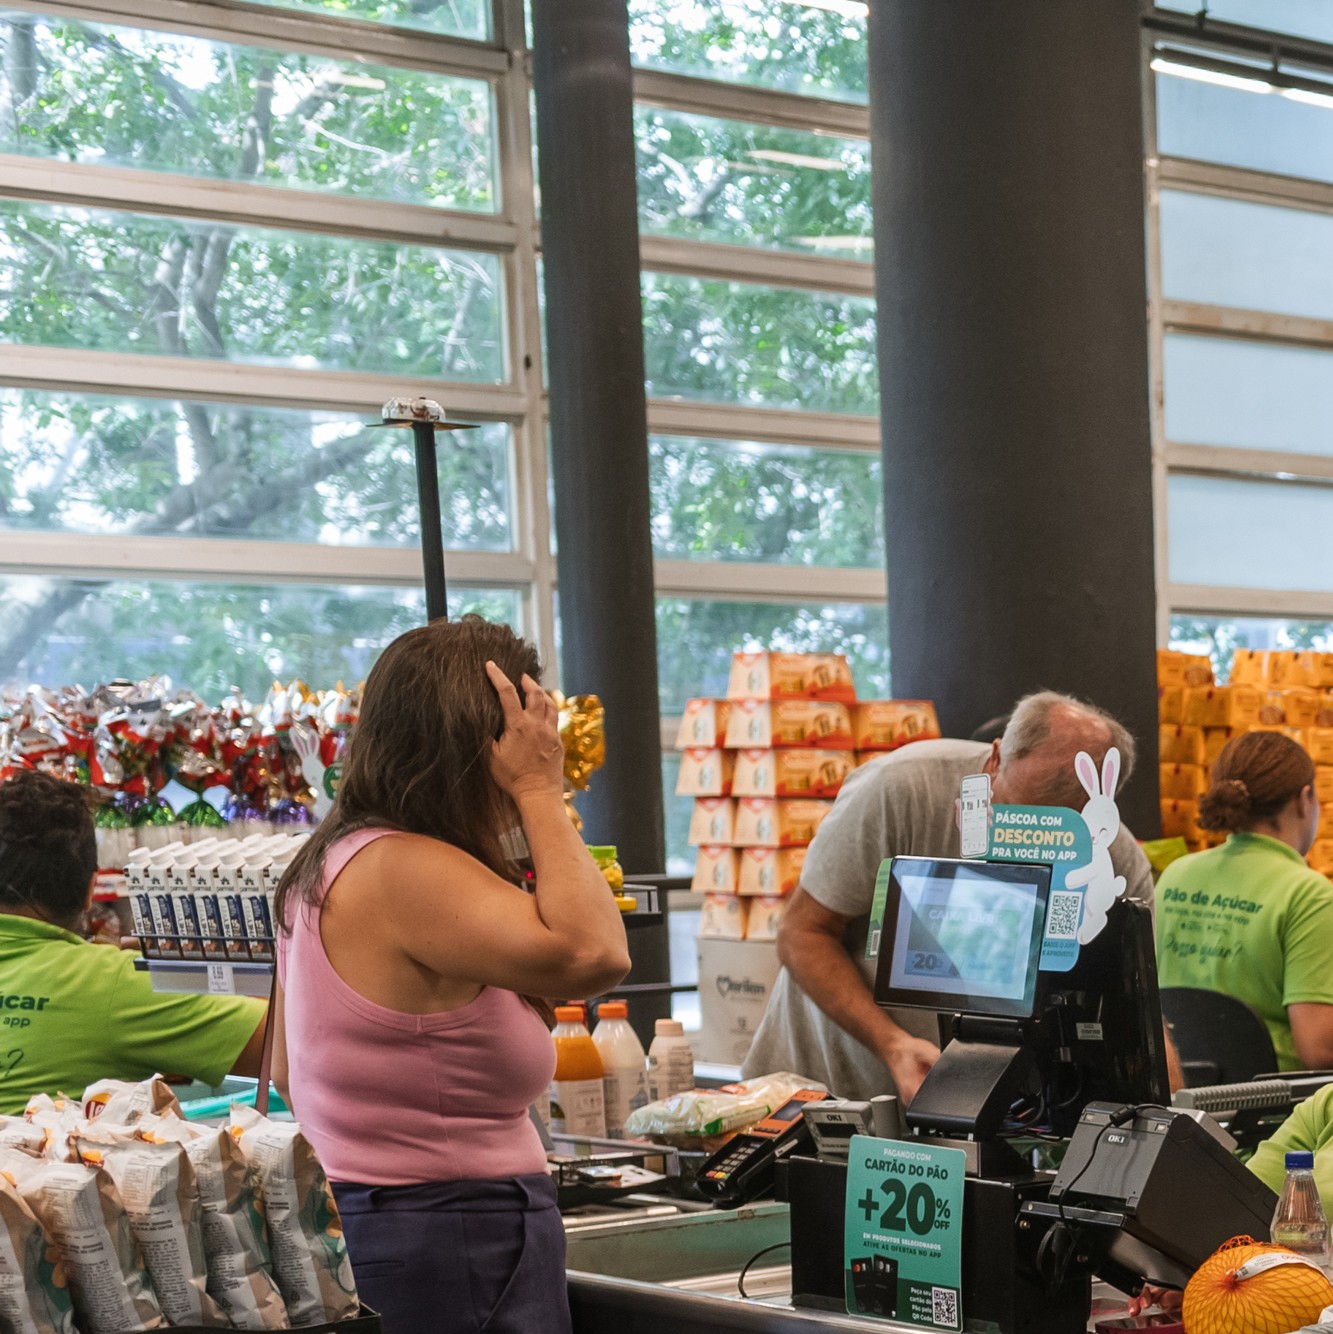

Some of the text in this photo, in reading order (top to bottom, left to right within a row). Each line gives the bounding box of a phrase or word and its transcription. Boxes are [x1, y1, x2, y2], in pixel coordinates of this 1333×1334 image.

[995, 810, 1063, 826] PÁSCOA COM
[994, 828, 1075, 847] DESCONTO
[992, 846, 1077, 860] PRA VOCÊ NO APP
[1163, 888, 1263, 914] Pão de Açúcar
[0, 991, 50, 1011] car
[3, 1017, 31, 1028] app
[826, 1113, 843, 1122] OKI
[1108, 1133, 1125, 1144] OKI
[883, 1148, 932, 1161] PAGANDO COM
[864, 1158, 949, 1180] CARTÃO DO PÃO
[934, 1219, 950, 1231] OFF
[863, 1241, 879, 1249] ATIVE
[881, 1243, 889, 1251] AS
[891, 1245, 917, 1255] OFERTAS
[918, 1249, 927, 1257] NO
[872, 1233, 900, 1244] PRODUTOS
[902, 1238, 941, 1250] SELECIONADOS
[920, 1314, 932, 1322] Code
